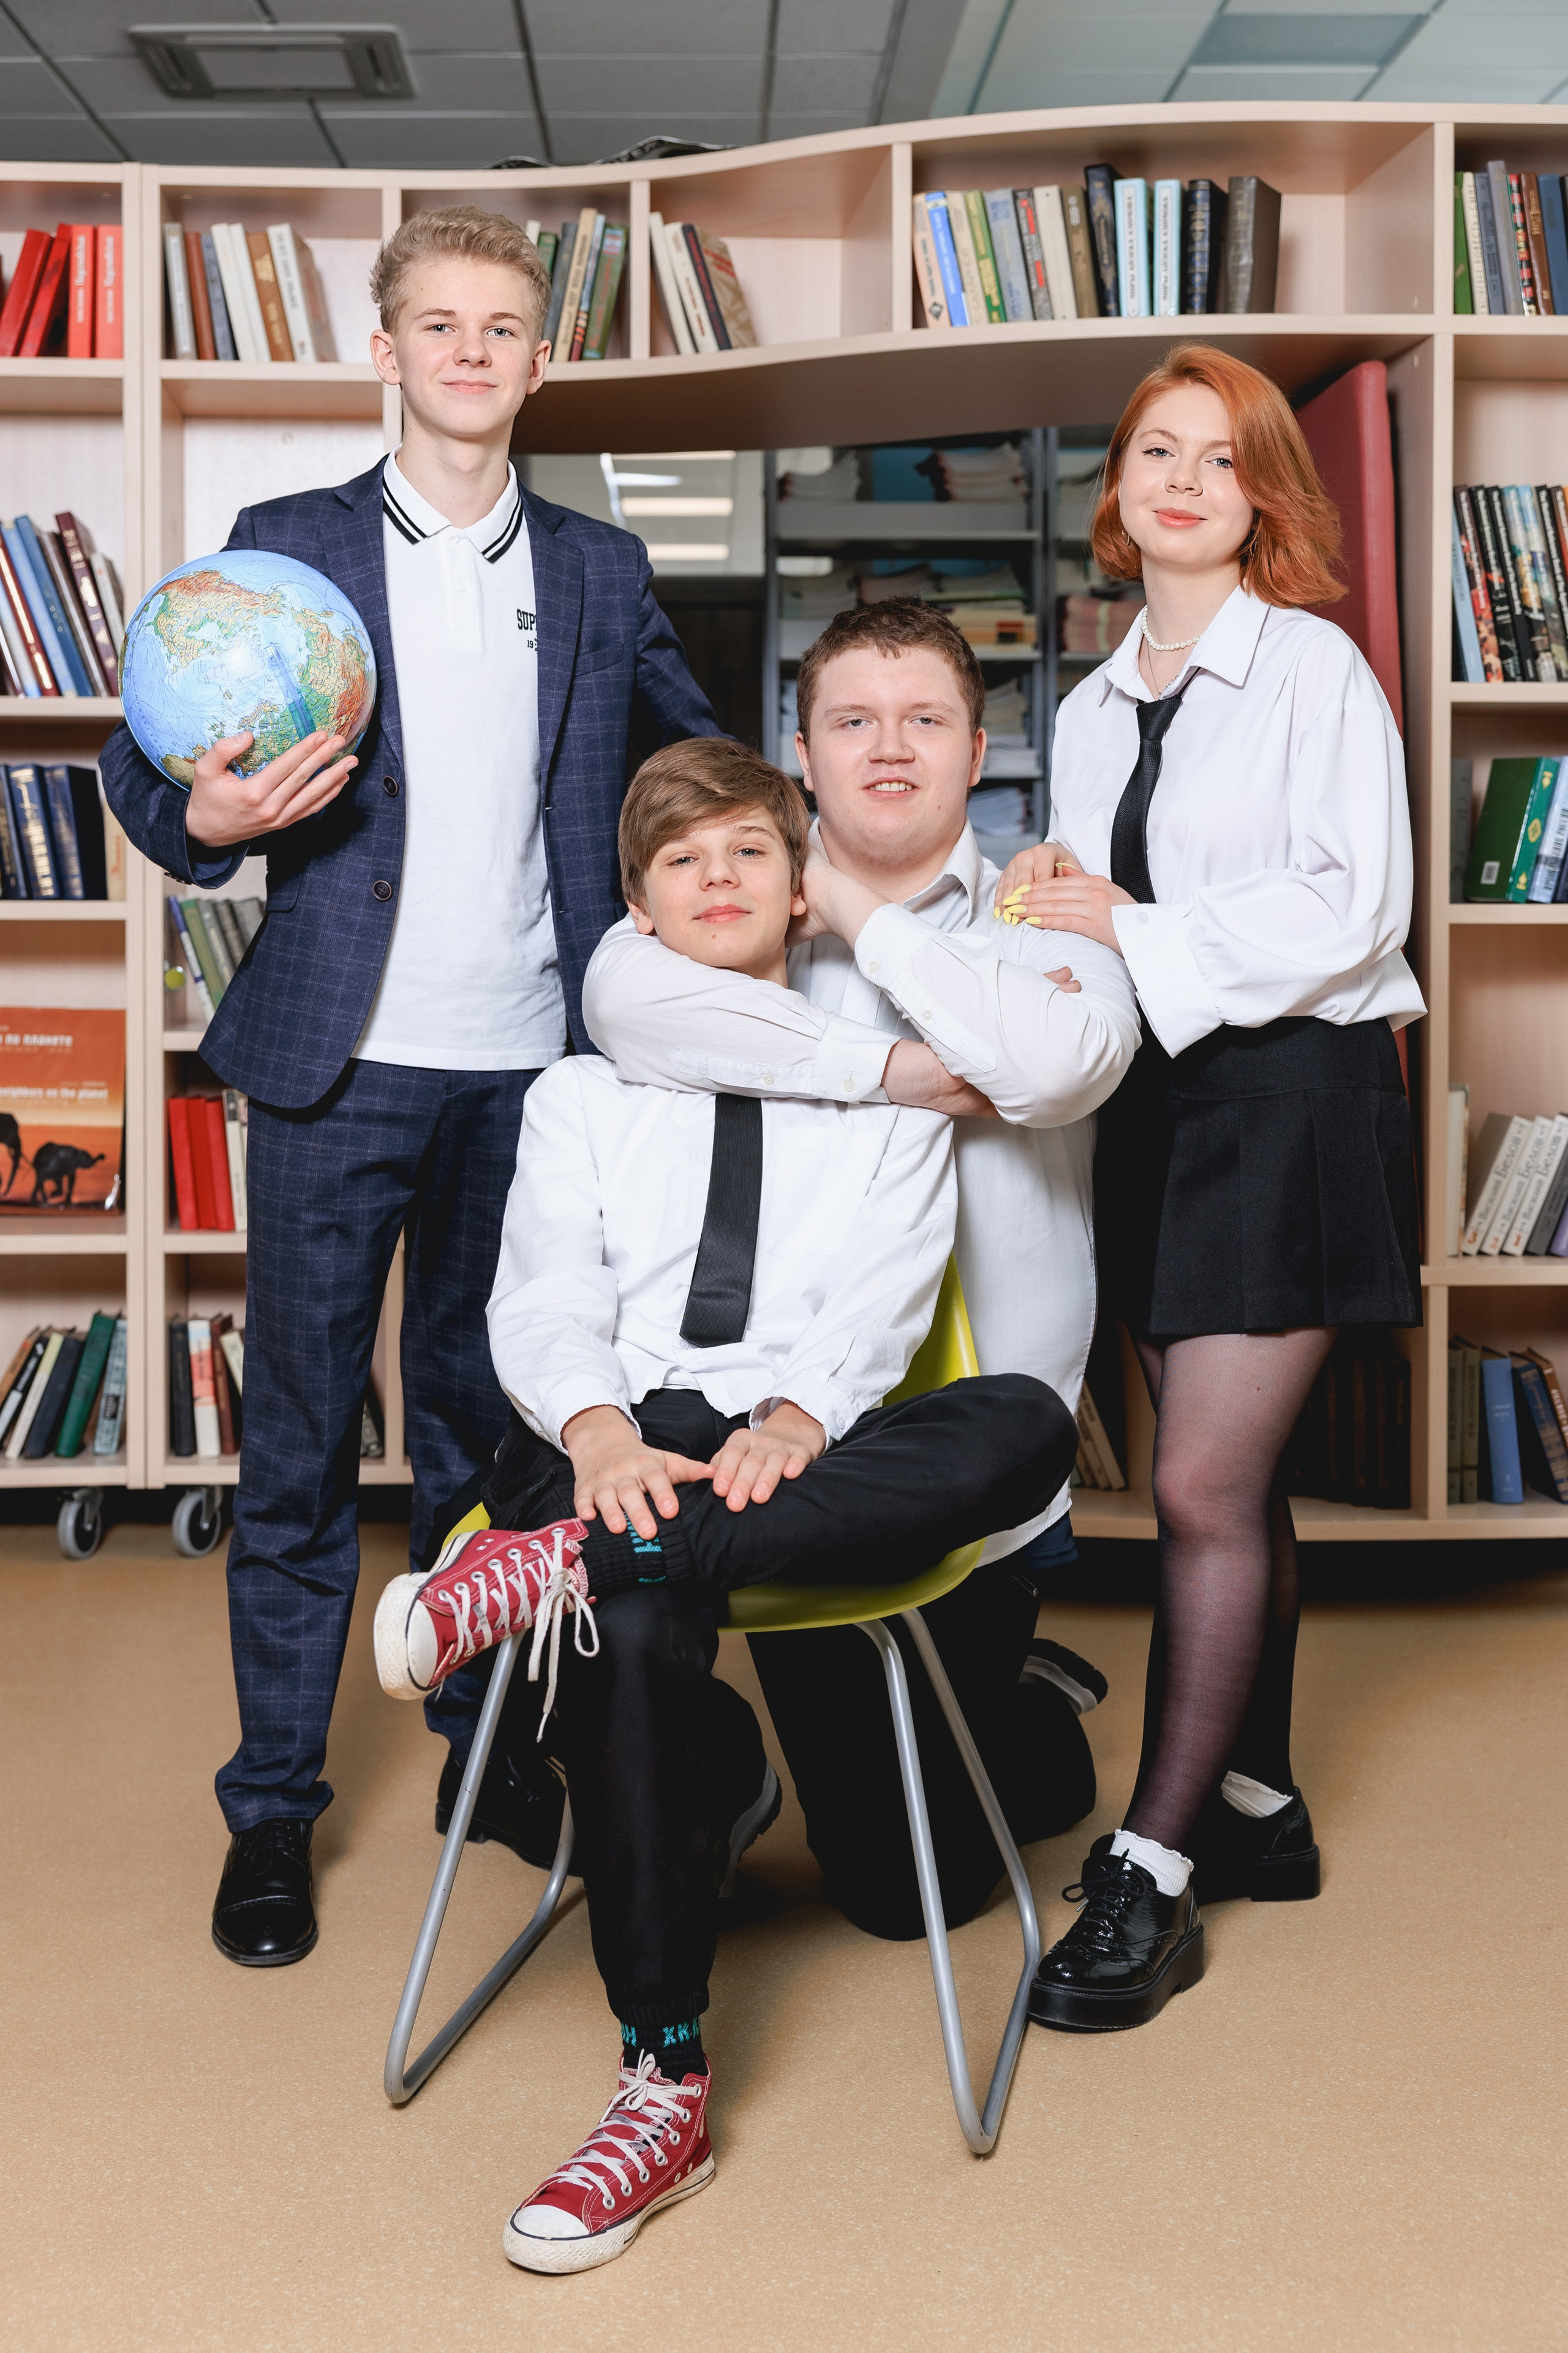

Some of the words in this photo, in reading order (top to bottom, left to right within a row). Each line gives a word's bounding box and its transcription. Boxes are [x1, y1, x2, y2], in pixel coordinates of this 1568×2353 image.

[1495, 501, 1506, 527] Illustrated
[1541, 502, 1553, 530] Illustrated
[1547, 530, 1559, 559] Reference
[1500, 526, 1511, 553] Reference
[516, 608, 537, 631] SUP
[527, 640, 533, 648] 19
[1494, 1135, 1521, 1179] Белов
[1516, 1135, 1545, 1179] Белов
[1536, 1133, 1562, 1177] Белов
